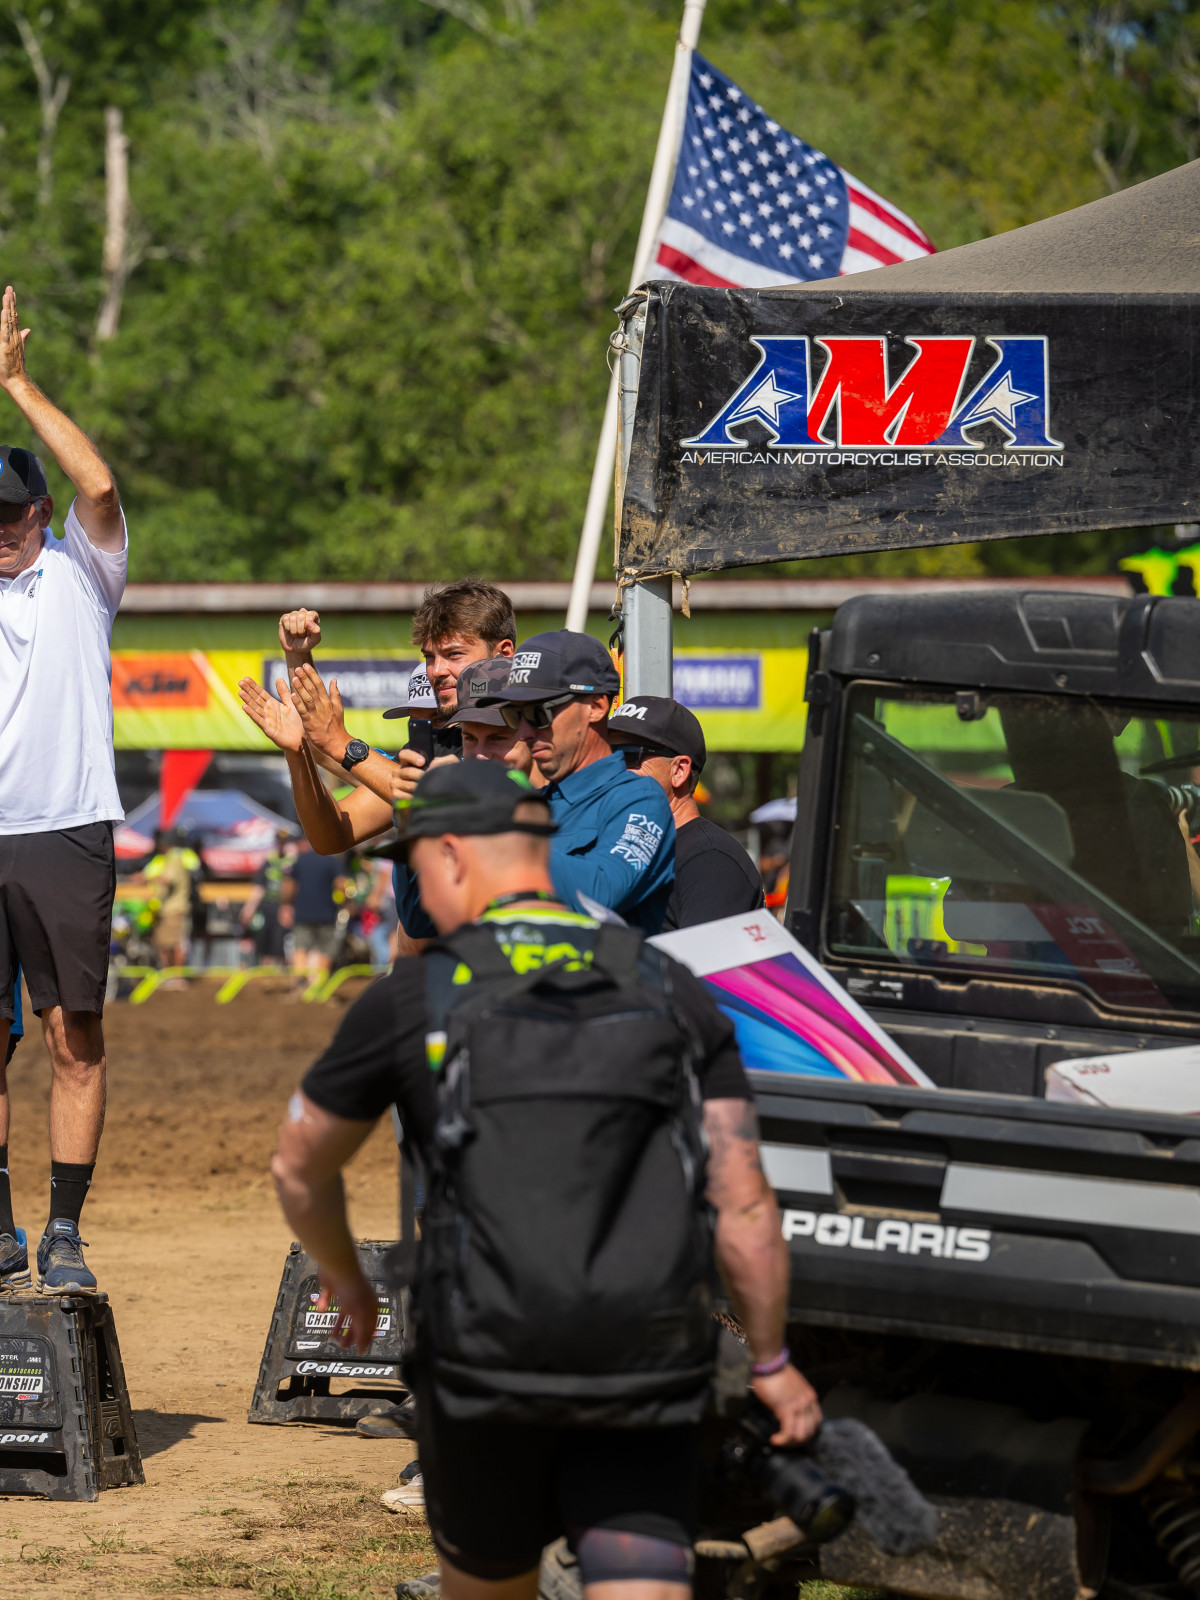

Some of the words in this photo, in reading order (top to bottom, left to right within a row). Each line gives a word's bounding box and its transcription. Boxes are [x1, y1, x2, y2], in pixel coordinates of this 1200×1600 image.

[679, 335, 1065, 450] AMA
[679, 452, 781, 465] AMERICAN
[783, 452, 934, 466] MOTORCYCLIST
[935, 454, 1064, 467] ASSOCIATION
[124, 671, 190, 696] KTM
[408, 685, 432, 700] FXR
[628, 813, 664, 840] FXR
[781, 1209, 992, 1262] POLARIS
[296, 1360, 394, 1375] Polisport
